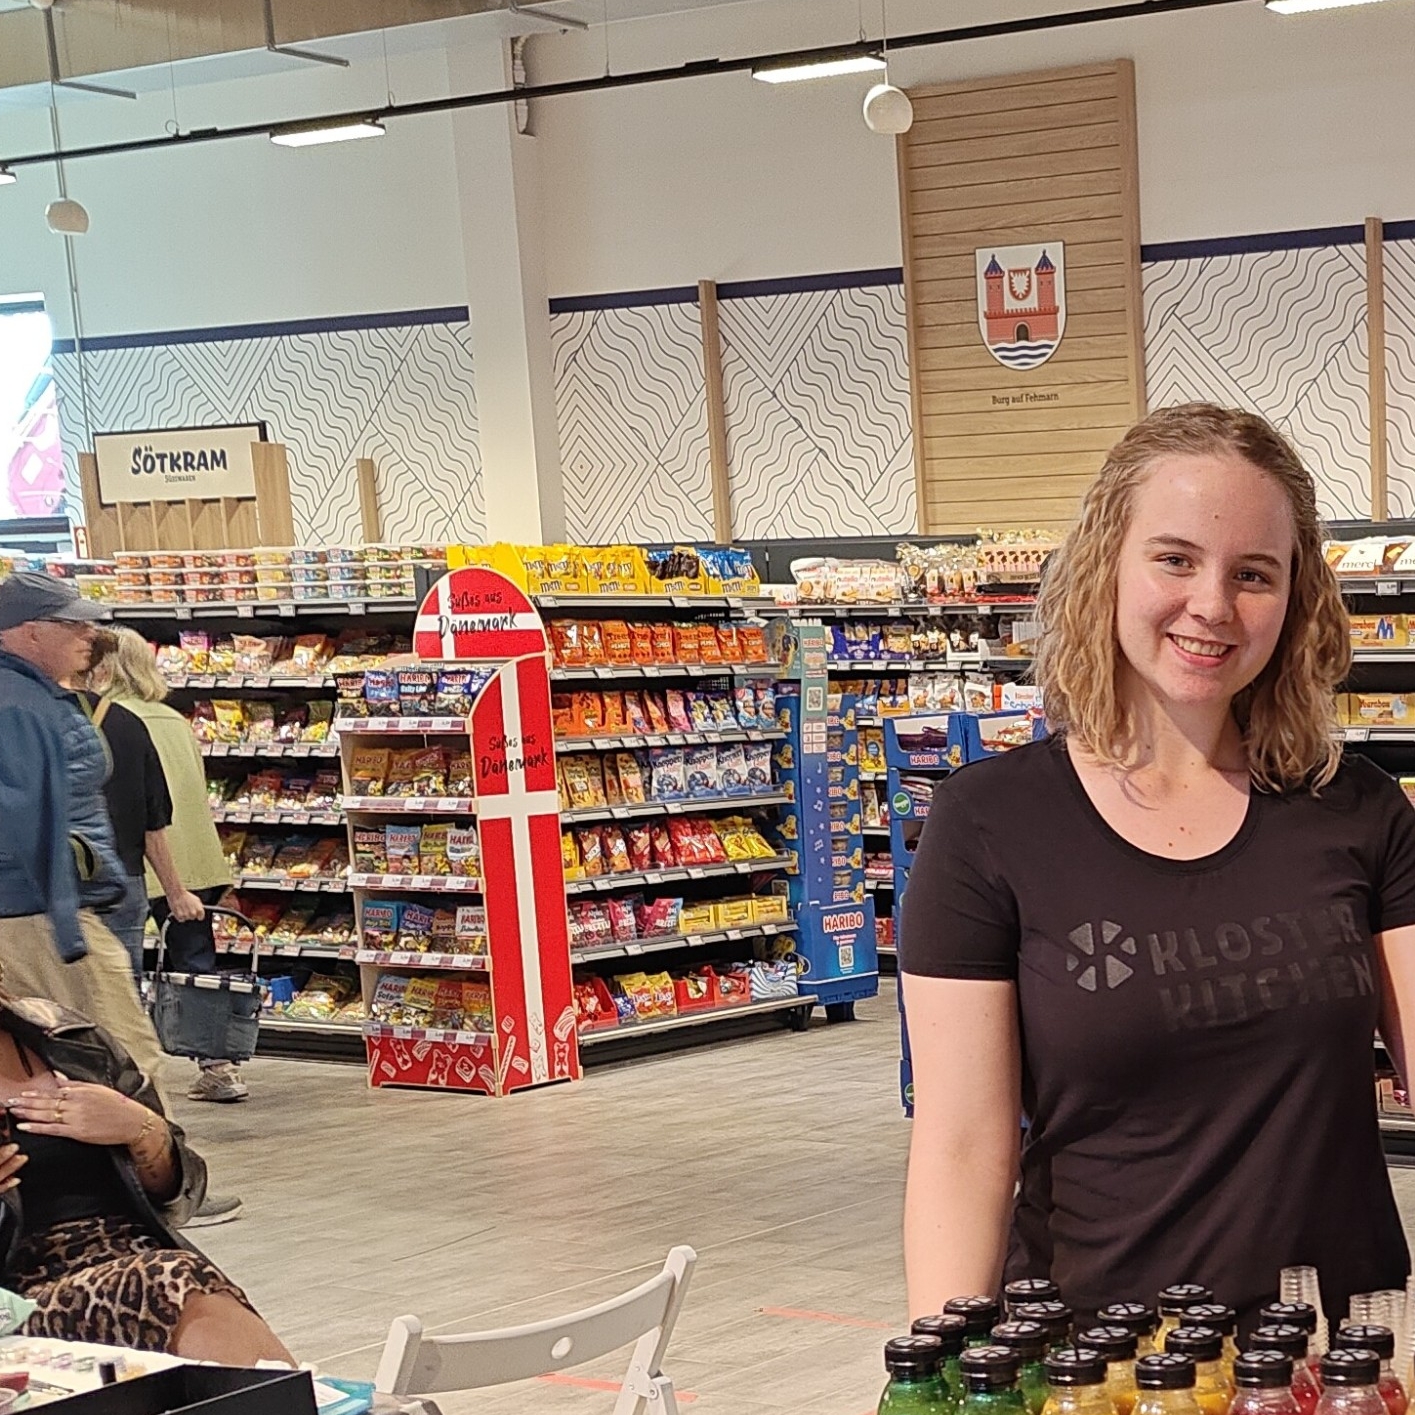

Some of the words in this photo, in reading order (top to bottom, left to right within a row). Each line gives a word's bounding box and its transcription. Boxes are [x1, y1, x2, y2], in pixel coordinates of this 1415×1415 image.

[992, 395, 1010, 406] Burg
[1011, 393, 1024, 403] auf
[1025, 392, 1060, 403] Fehmarn
[131, 445, 228, 475] SÖTKRAM
[438, 607, 518, 639] Dänemark
[910, 755, 940, 766] HARIBO
[824, 912, 863, 931] HARIBO
[1147, 903, 1363, 977] KLOSTER
